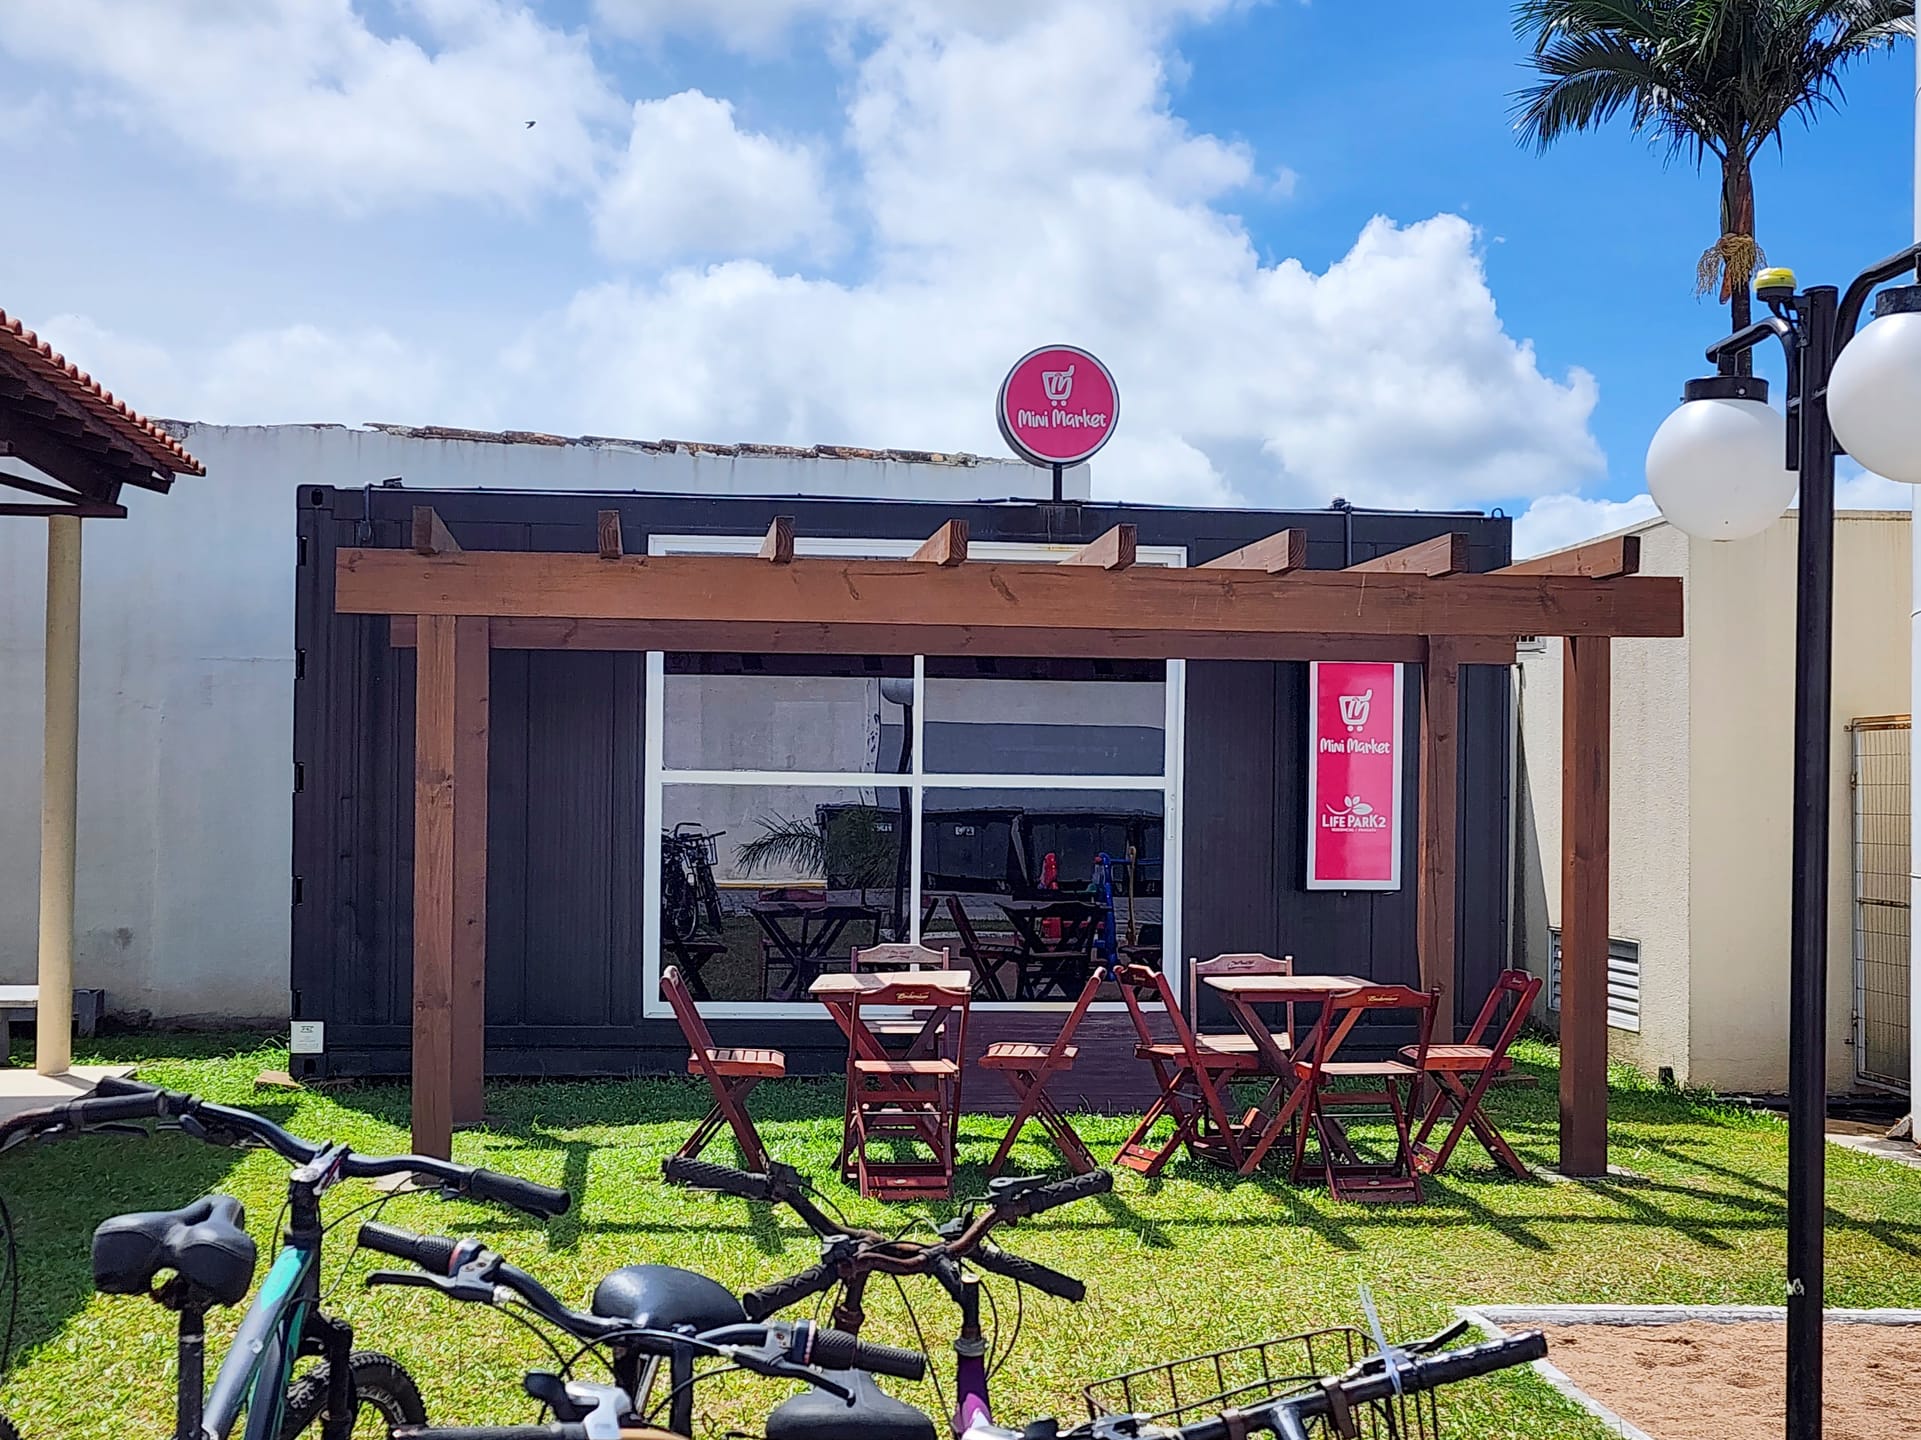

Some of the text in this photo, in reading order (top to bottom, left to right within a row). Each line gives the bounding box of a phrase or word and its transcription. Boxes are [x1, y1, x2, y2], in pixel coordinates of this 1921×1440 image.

[1017, 409, 1107, 428] Mini Market
[1320, 737, 1391, 754] Mini Market
[1322, 814, 1346, 827] LIFE
